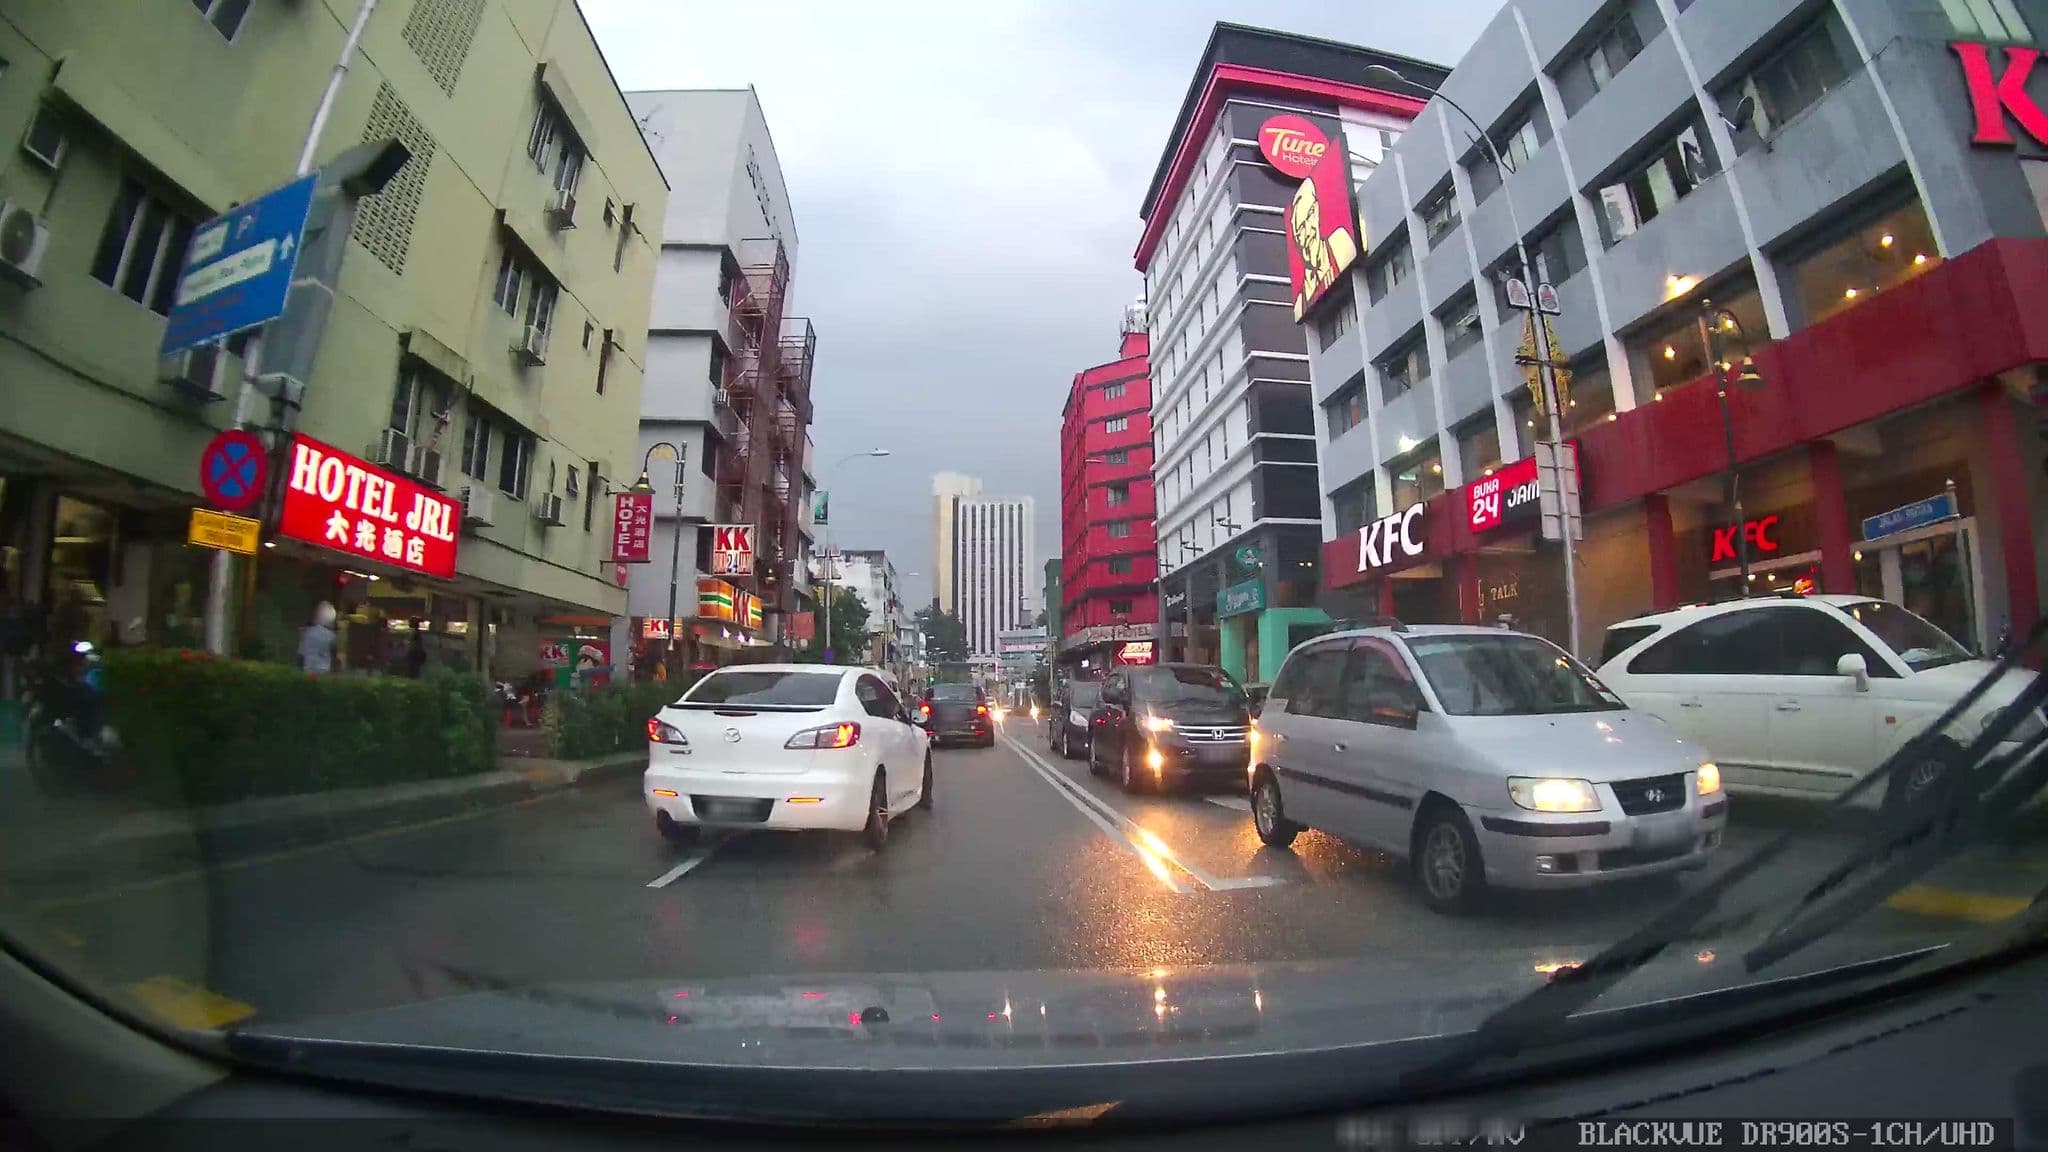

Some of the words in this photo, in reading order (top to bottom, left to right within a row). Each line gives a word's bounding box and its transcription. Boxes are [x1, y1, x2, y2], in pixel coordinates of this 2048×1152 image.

[1265, 127, 1326, 158] Tune
[290, 443, 398, 523] HOTEL
[406, 493, 454, 542] JRL
[1472, 493, 1499, 525] 24
[1507, 480, 1540, 508] JAM
[1473, 478, 1499, 500] BUKA
[325, 509, 426, 566] 大光酒店
[617, 496, 634, 557] HOTEL
[716, 526, 750, 551] KK
[1357, 502, 1424, 573] KFC
[1711, 514, 1779, 562] KFC
[733, 587, 751, 627] KK
[1117, 626, 1151, 639] HOTEL
